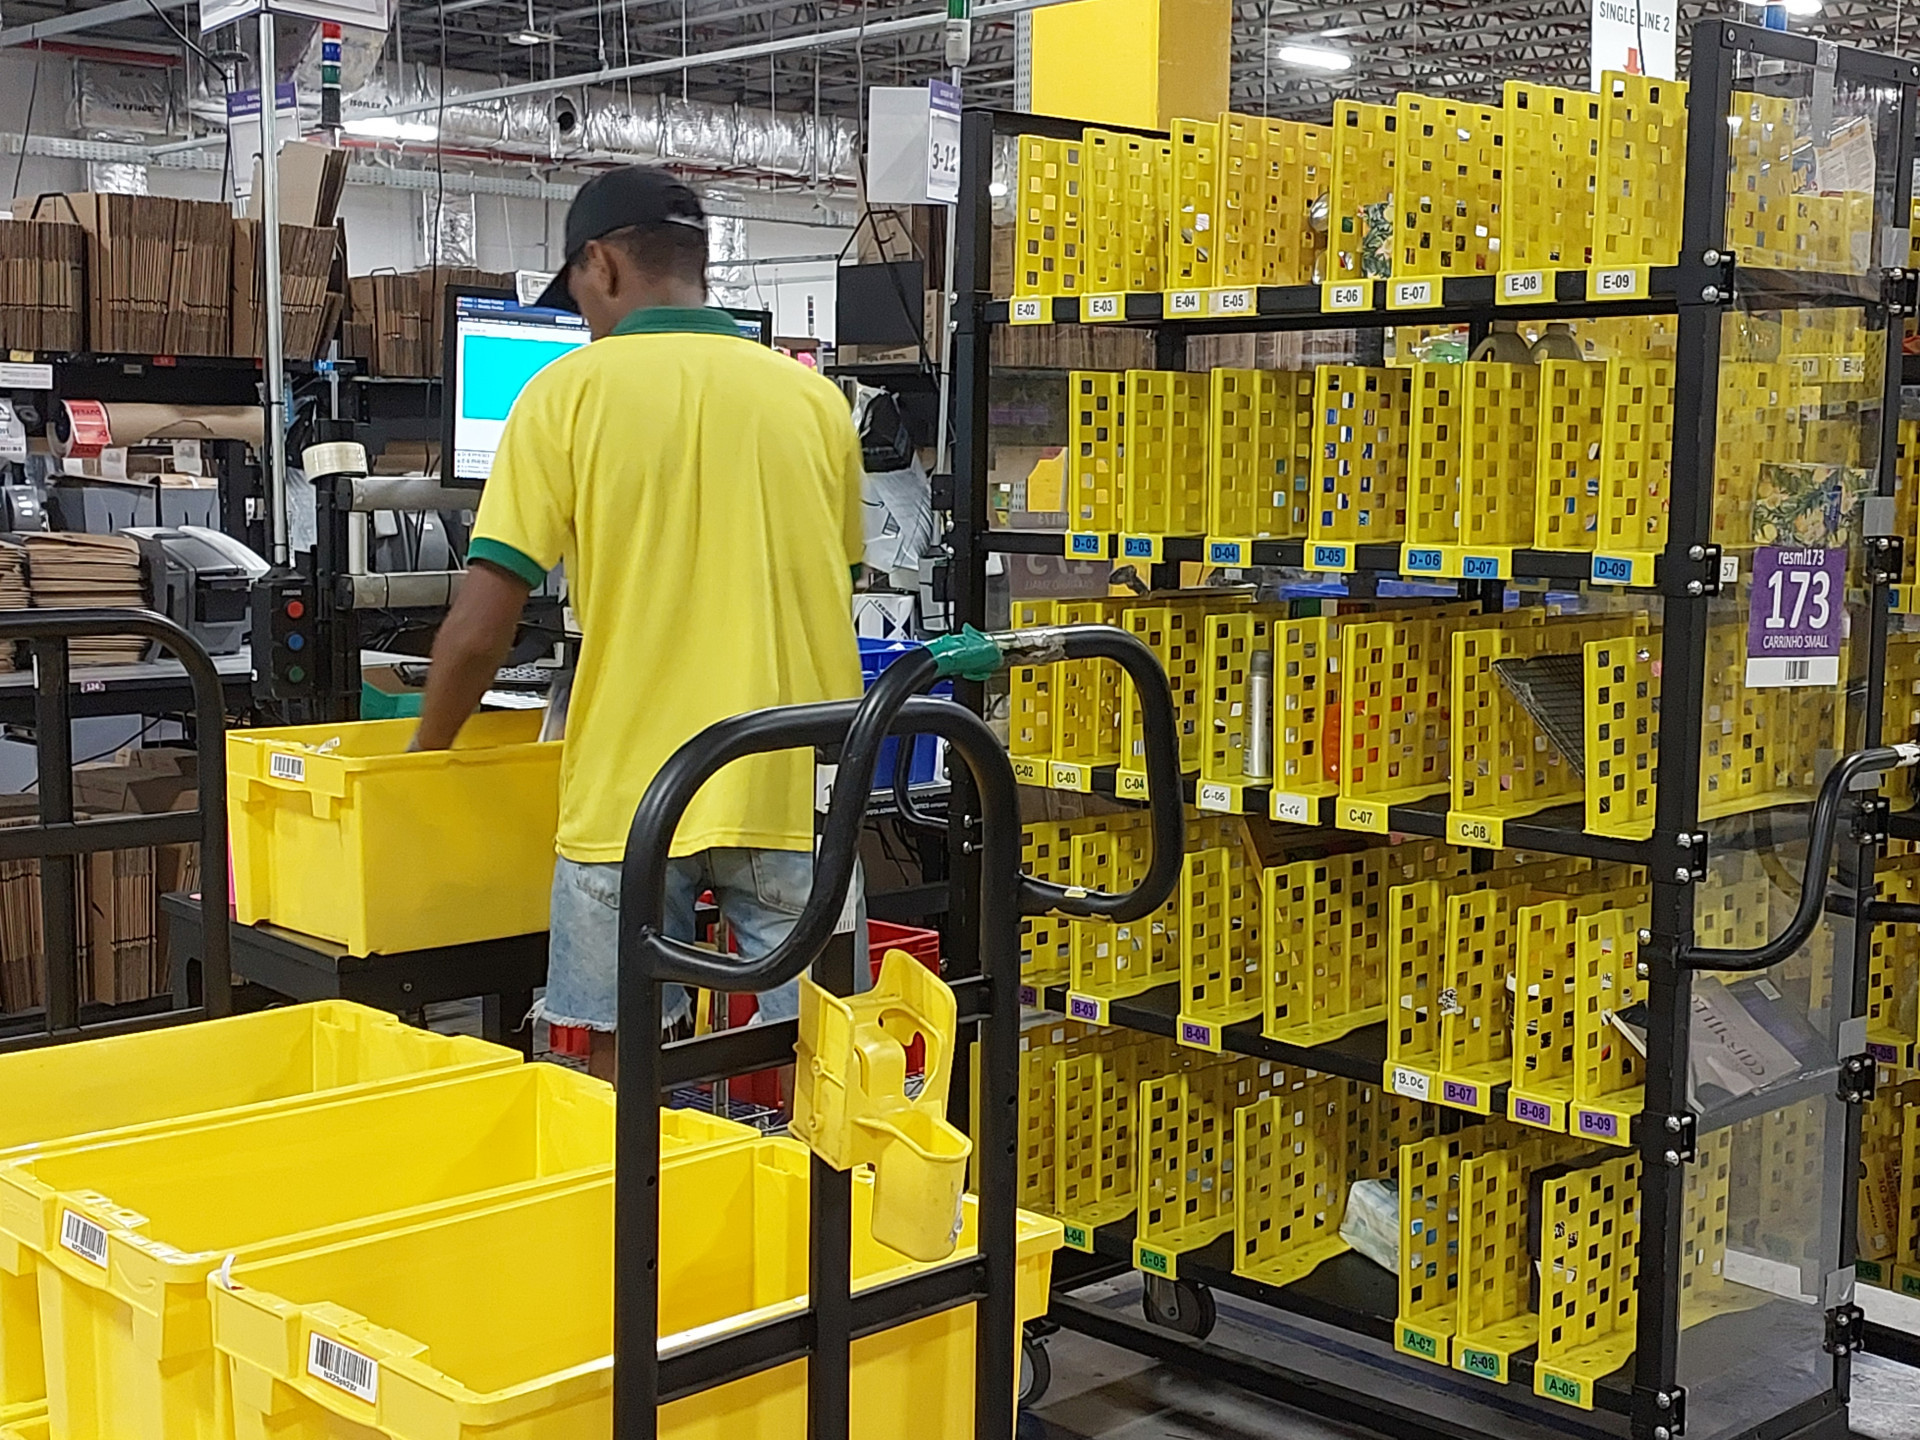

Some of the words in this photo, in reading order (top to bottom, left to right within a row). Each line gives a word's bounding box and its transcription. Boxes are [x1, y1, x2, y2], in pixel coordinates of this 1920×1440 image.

[1599, 1, 1636, 25] SINGLE
[1639, 12, 1661, 31] INE
[1663, 16, 1670, 33] 2
[349, 99, 381, 109] ISOFLEX
[1511, 276, 1537, 291] E-08
[1603, 274, 1630, 289] E-09
[1335, 289, 1358, 303] E-06
[1401, 286, 1425, 300] E-07
[1093, 300, 1112, 313] E-03
[1175, 295, 1195, 308] E-04
[1222, 294, 1244, 308] E-05
[1017, 304, 1035, 315] E-02
[1073, 537, 1098, 550] D-02
[1126, 540, 1151, 553] D-03
[1214, 546, 1235, 560] D-04
[1318, 549, 1341, 563] D-05
[1408, 553, 1440, 567] D-06
[1467, 560, 1493, 574] D-07
[1598, 560, 1626, 577] D-09
[1722, 563, 1735, 577] 57
[1765, 570, 1831, 629] 173
[1762, 635, 1804, 649] CARRINHO
[1804, 635, 1829, 648] SMALL
[1015, 764, 1034, 778] C-02
[1057, 771, 1076, 784] C-03
[1124, 778, 1145, 790] C-04
[1349, 809, 1373, 825] C-07
[1461, 824, 1486, 839] C-08
[1074, 1002, 1094, 1017] B-03
[1186, 1026, 1206, 1041] B-04
[1448, 1085, 1472, 1101] B-07
[1520, 1103, 1545, 1120] B-08
[1584, 1115, 1611, 1131] B-09
[1141, 1250, 1166, 1269] A-05
[1407, 1333, 1432, 1352] A-07
[1470, 1354, 1495, 1370] A-08
[1549, 1378, 1576, 1398] A-09
